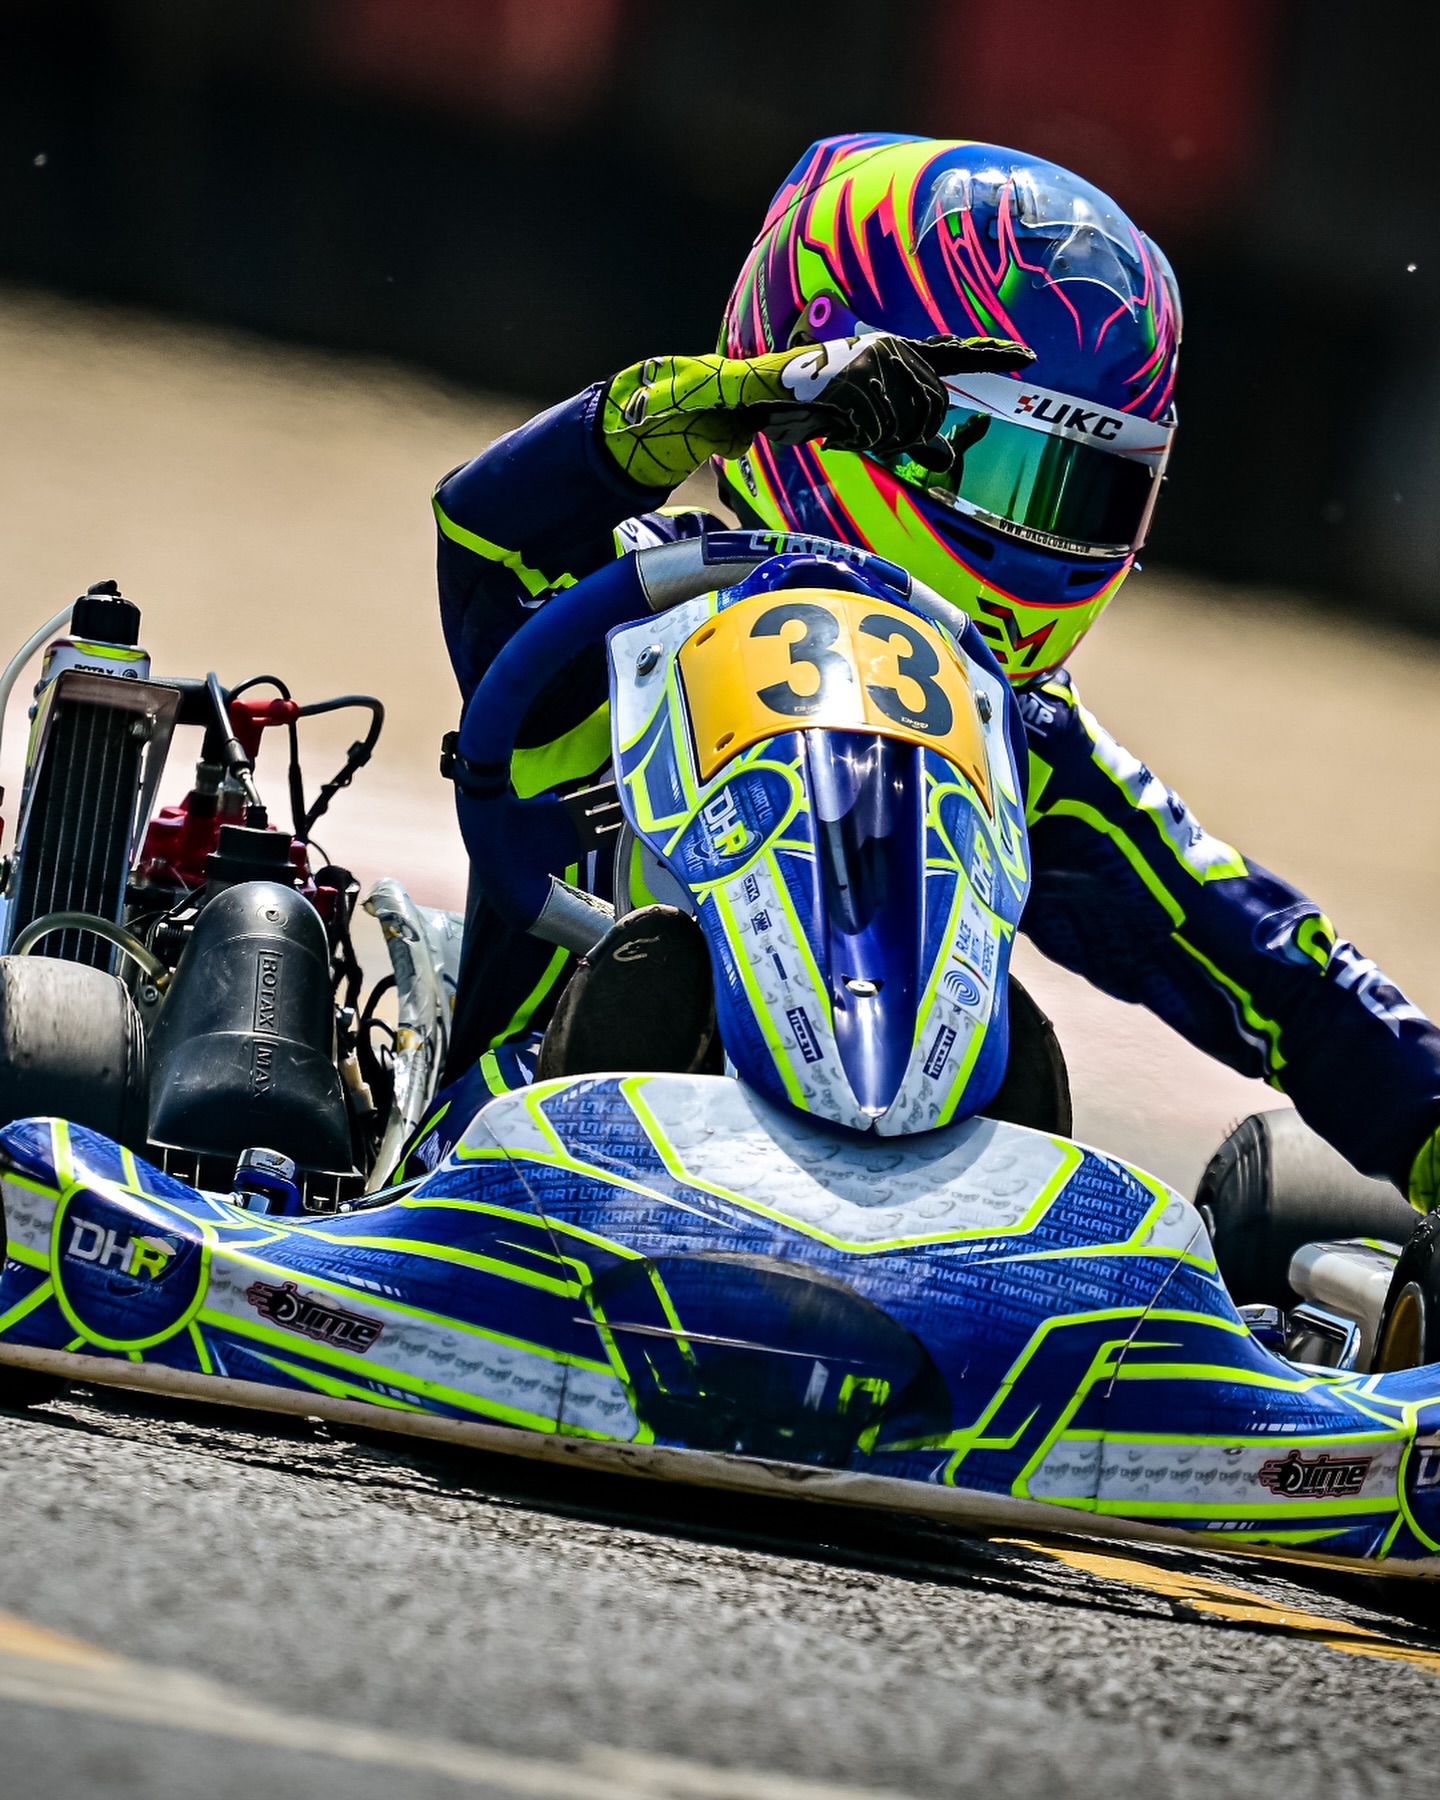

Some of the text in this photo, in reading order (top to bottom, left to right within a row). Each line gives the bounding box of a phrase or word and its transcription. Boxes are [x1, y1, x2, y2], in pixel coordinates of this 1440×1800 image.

[1031, 398, 1123, 440] UKC
[750, 602, 953, 736] 33
[1018, 694, 1054, 725] MP
[703, 785, 747, 855] DHR
[955, 919, 972, 955] RACE
[254, 956, 277, 1097] ROTAX MAX
[70, 1216, 168, 1280] DHR
